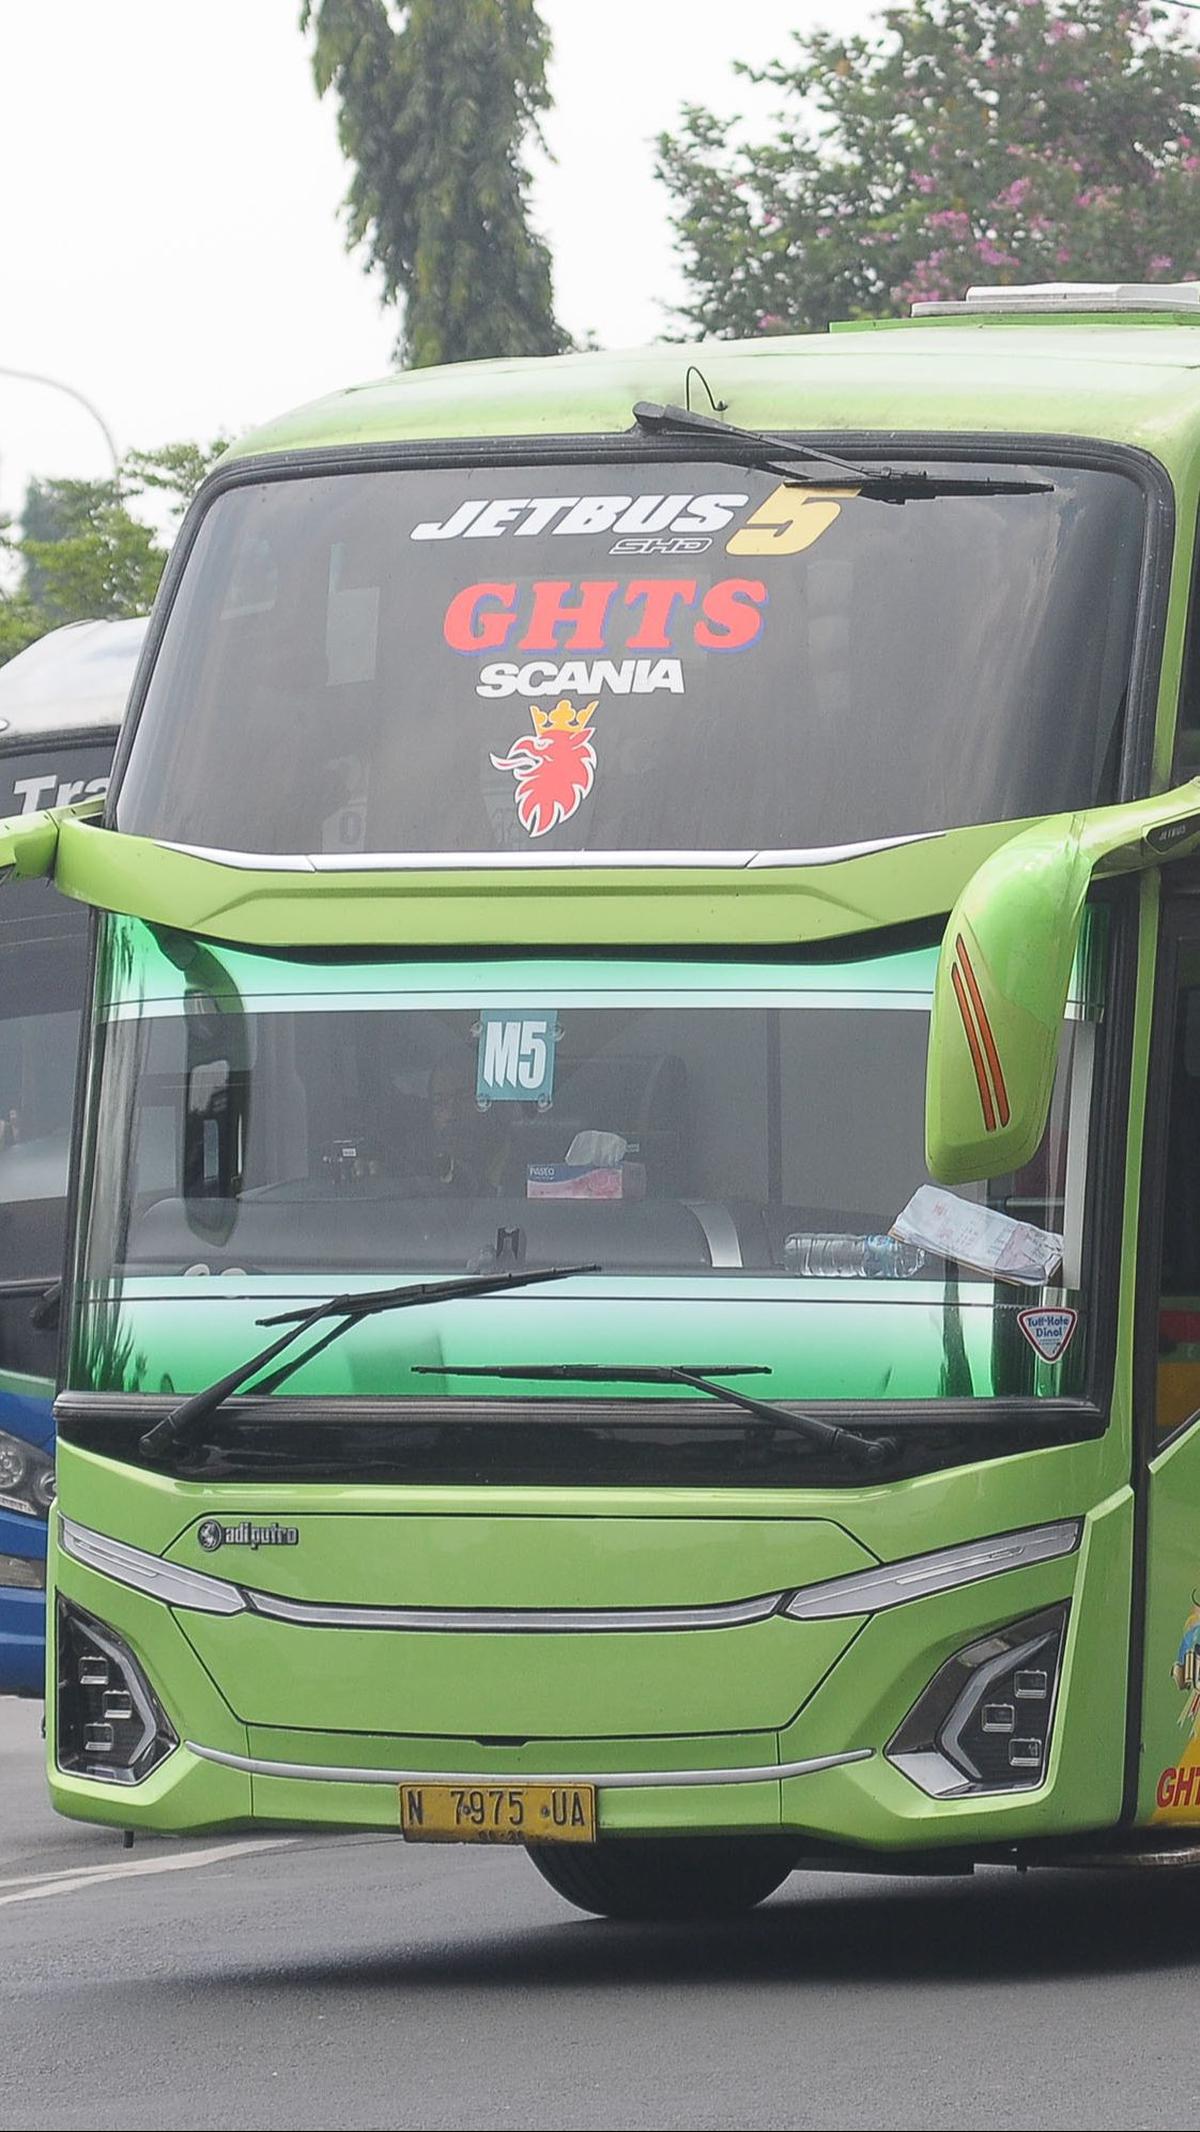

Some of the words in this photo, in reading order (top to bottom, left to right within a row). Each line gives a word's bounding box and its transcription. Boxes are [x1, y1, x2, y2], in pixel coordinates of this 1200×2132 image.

[410, 494, 749, 540] JETBUS
[725, 483, 861, 555] 5
[609, 538, 712, 554] SHD
[443, 578, 769, 656] GHTS
[476, 659, 685, 698] SCANIA
[483, 1021, 547, 1089] M5
[1036, 1327, 1062, 1337] Dinol
[407, 1791, 423, 1825] N
[451, 1791, 524, 1825] 7975
[552, 1790, 585, 1826] UA
